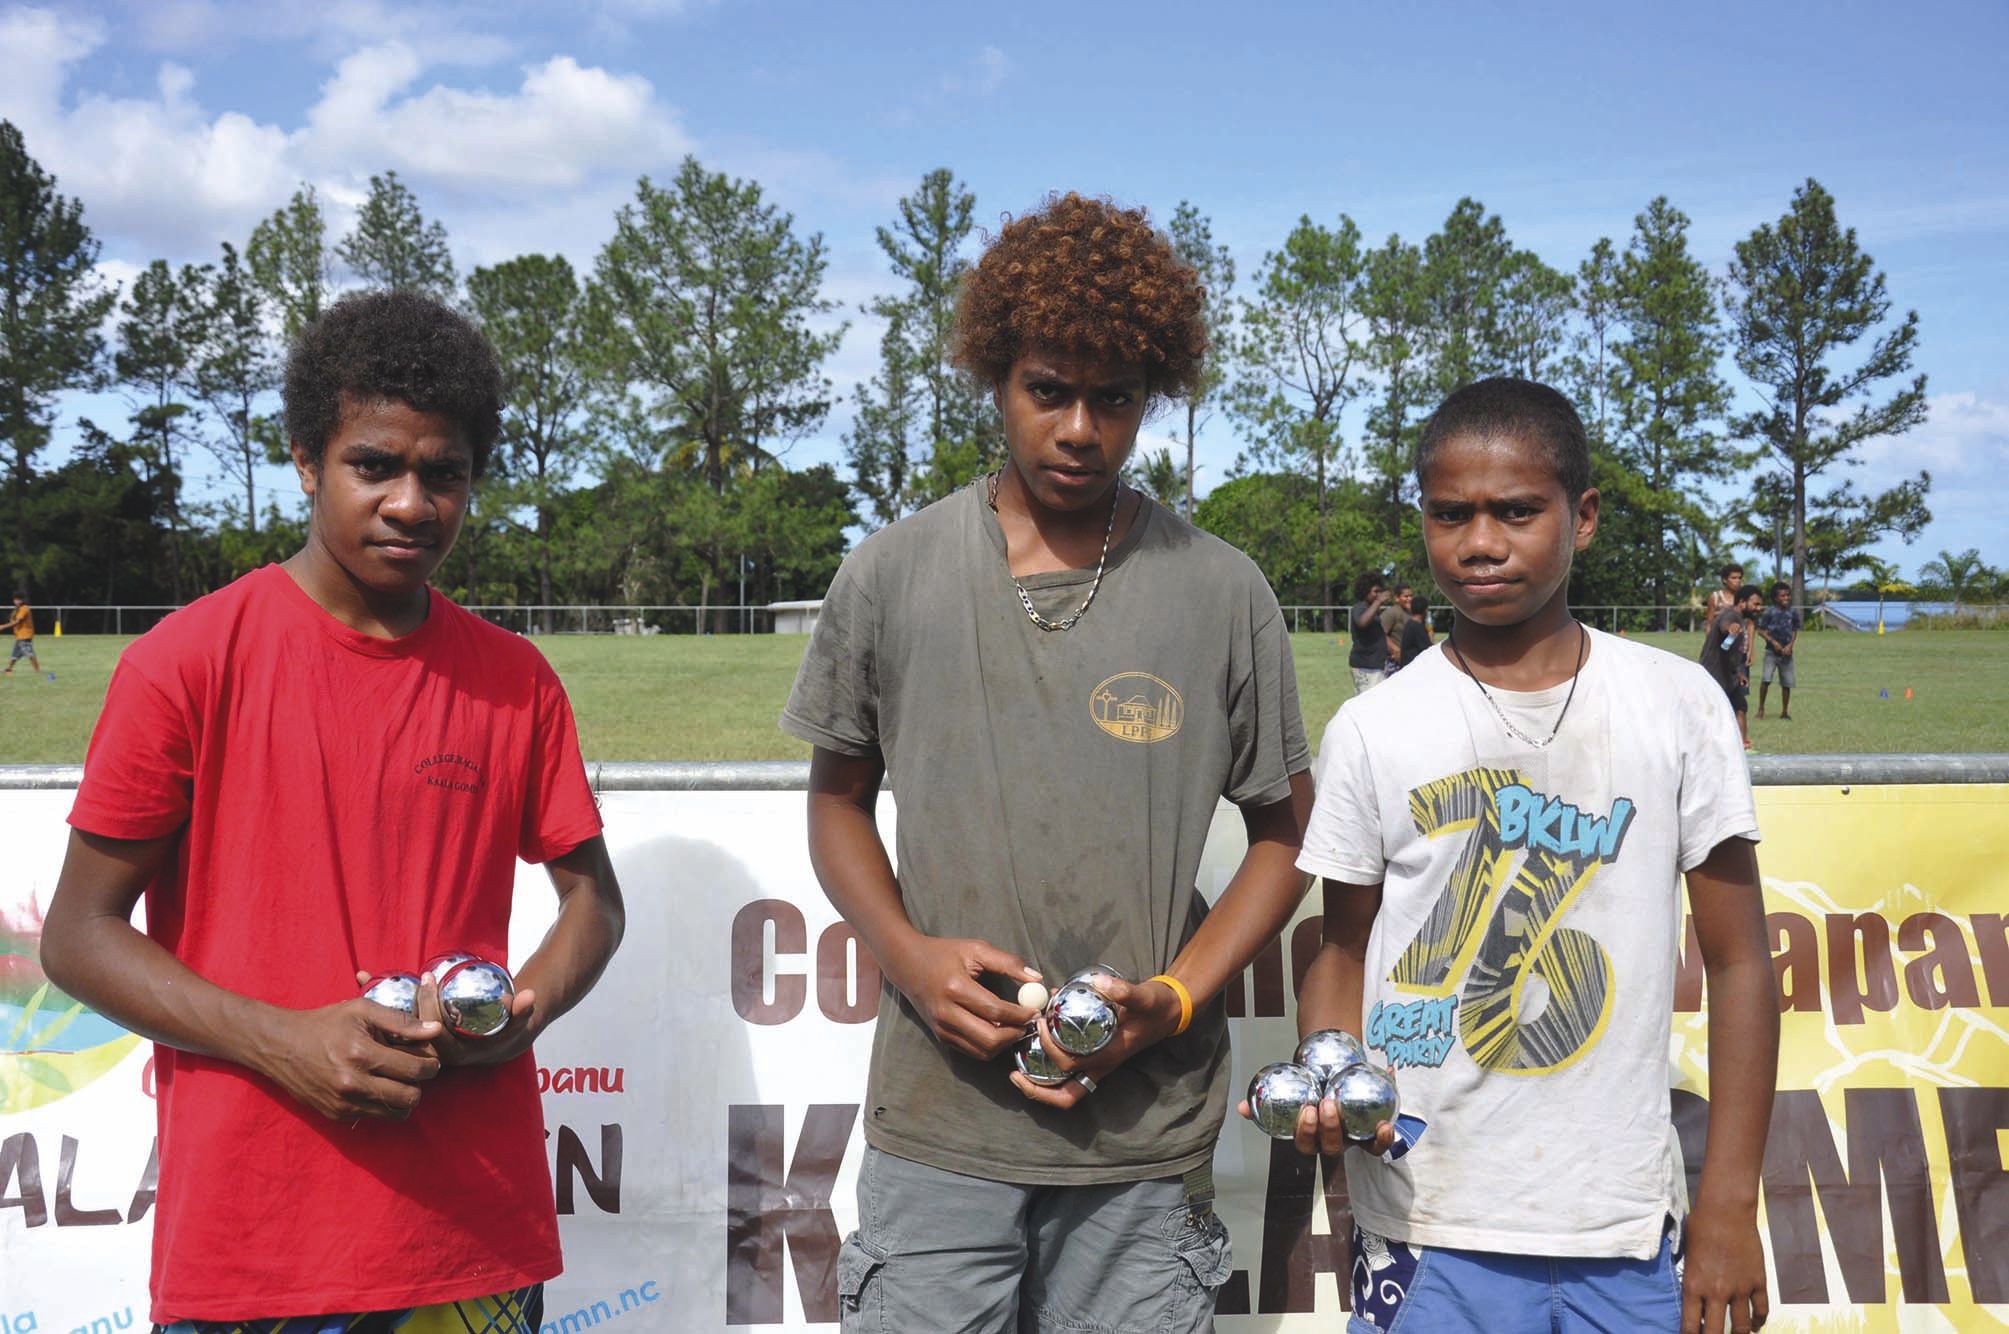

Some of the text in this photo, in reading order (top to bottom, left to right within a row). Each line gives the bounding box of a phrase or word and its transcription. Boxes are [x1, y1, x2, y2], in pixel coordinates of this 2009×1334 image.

[1367, 995, 1458, 1051] GREAT
[1385, 1036, 1457, 1070] PARTY
[537, 1066, 625, 1094] panu
